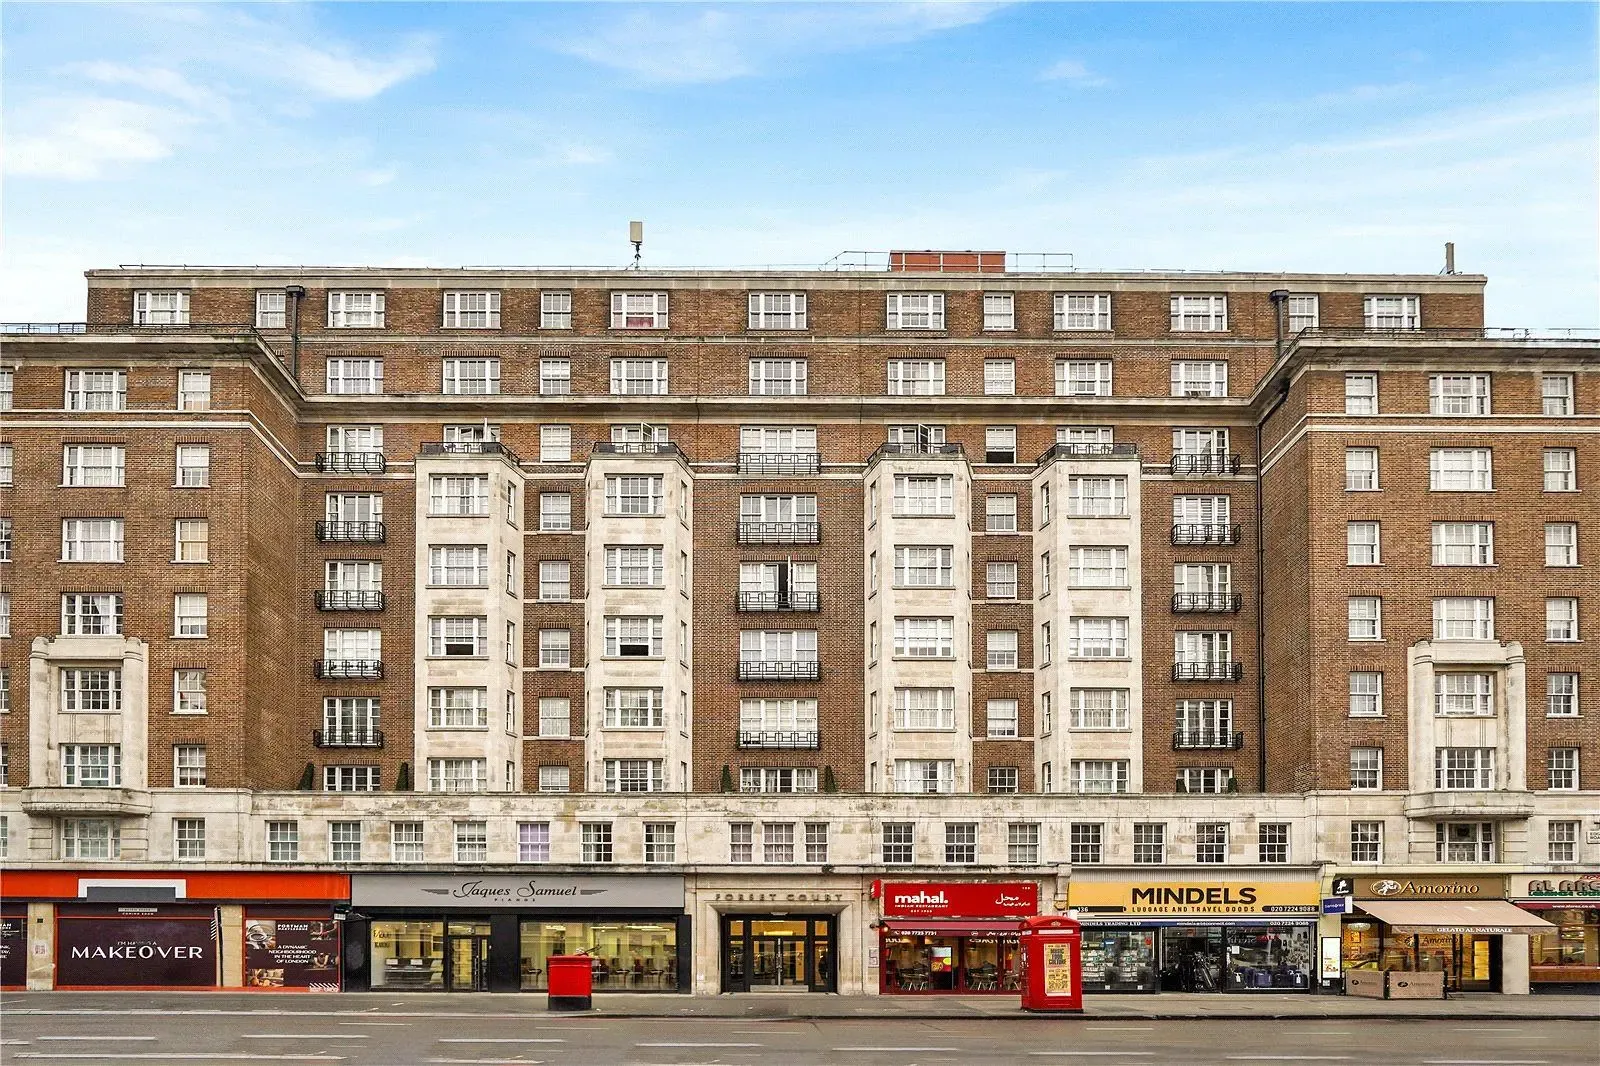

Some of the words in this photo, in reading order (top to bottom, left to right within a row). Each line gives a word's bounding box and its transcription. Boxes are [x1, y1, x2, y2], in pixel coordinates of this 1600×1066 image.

[452, 880, 511, 898] Jaques
[516, 880, 577, 897] Samuel
[1400, 881, 1480, 894] Amorino
[1528, 880, 1555, 891] AL
[895, 891, 949, 904] mahal.
[1131, 887, 1257, 905] MINDELS
[71, 946, 203, 959] MAKEOVER
